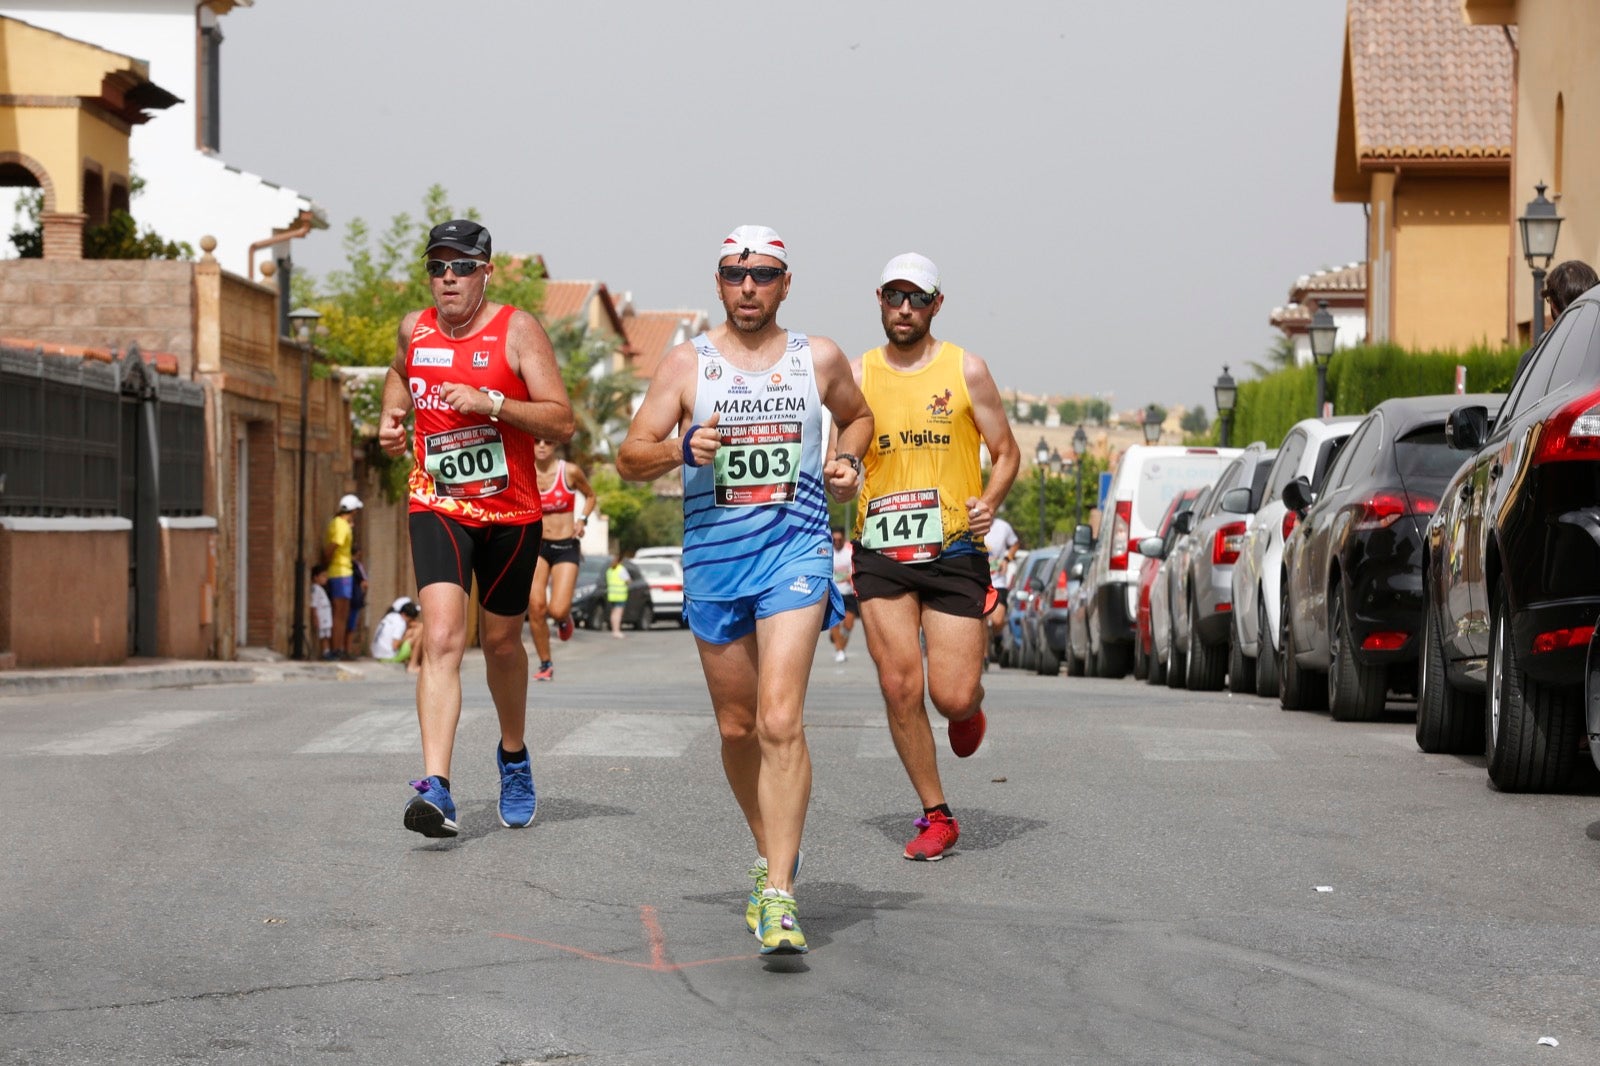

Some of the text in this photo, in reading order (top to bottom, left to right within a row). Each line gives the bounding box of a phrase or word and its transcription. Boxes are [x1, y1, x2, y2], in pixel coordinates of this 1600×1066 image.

[713, 397, 806, 413] MARACENA
[441, 433, 454, 444] GRAN
[454, 430, 472, 441] PREMIO
[472, 429, 479, 437] DE
[731, 425, 747, 437] GRAN
[747, 424, 769, 436] PREMIO
[770, 424, 778, 434] DE
[779, 423, 798, 434] FONDO
[899, 429, 951, 446] Vigilsa
[439, 448, 494, 479] 600
[727, 447, 791, 480] 503
[881, 496, 892, 507] GRAN
[892, 493, 910, 504] PREMIO
[910, 492, 917, 501] DE
[917, 491, 935, 500] FONDO
[876, 513, 928, 542] 147
